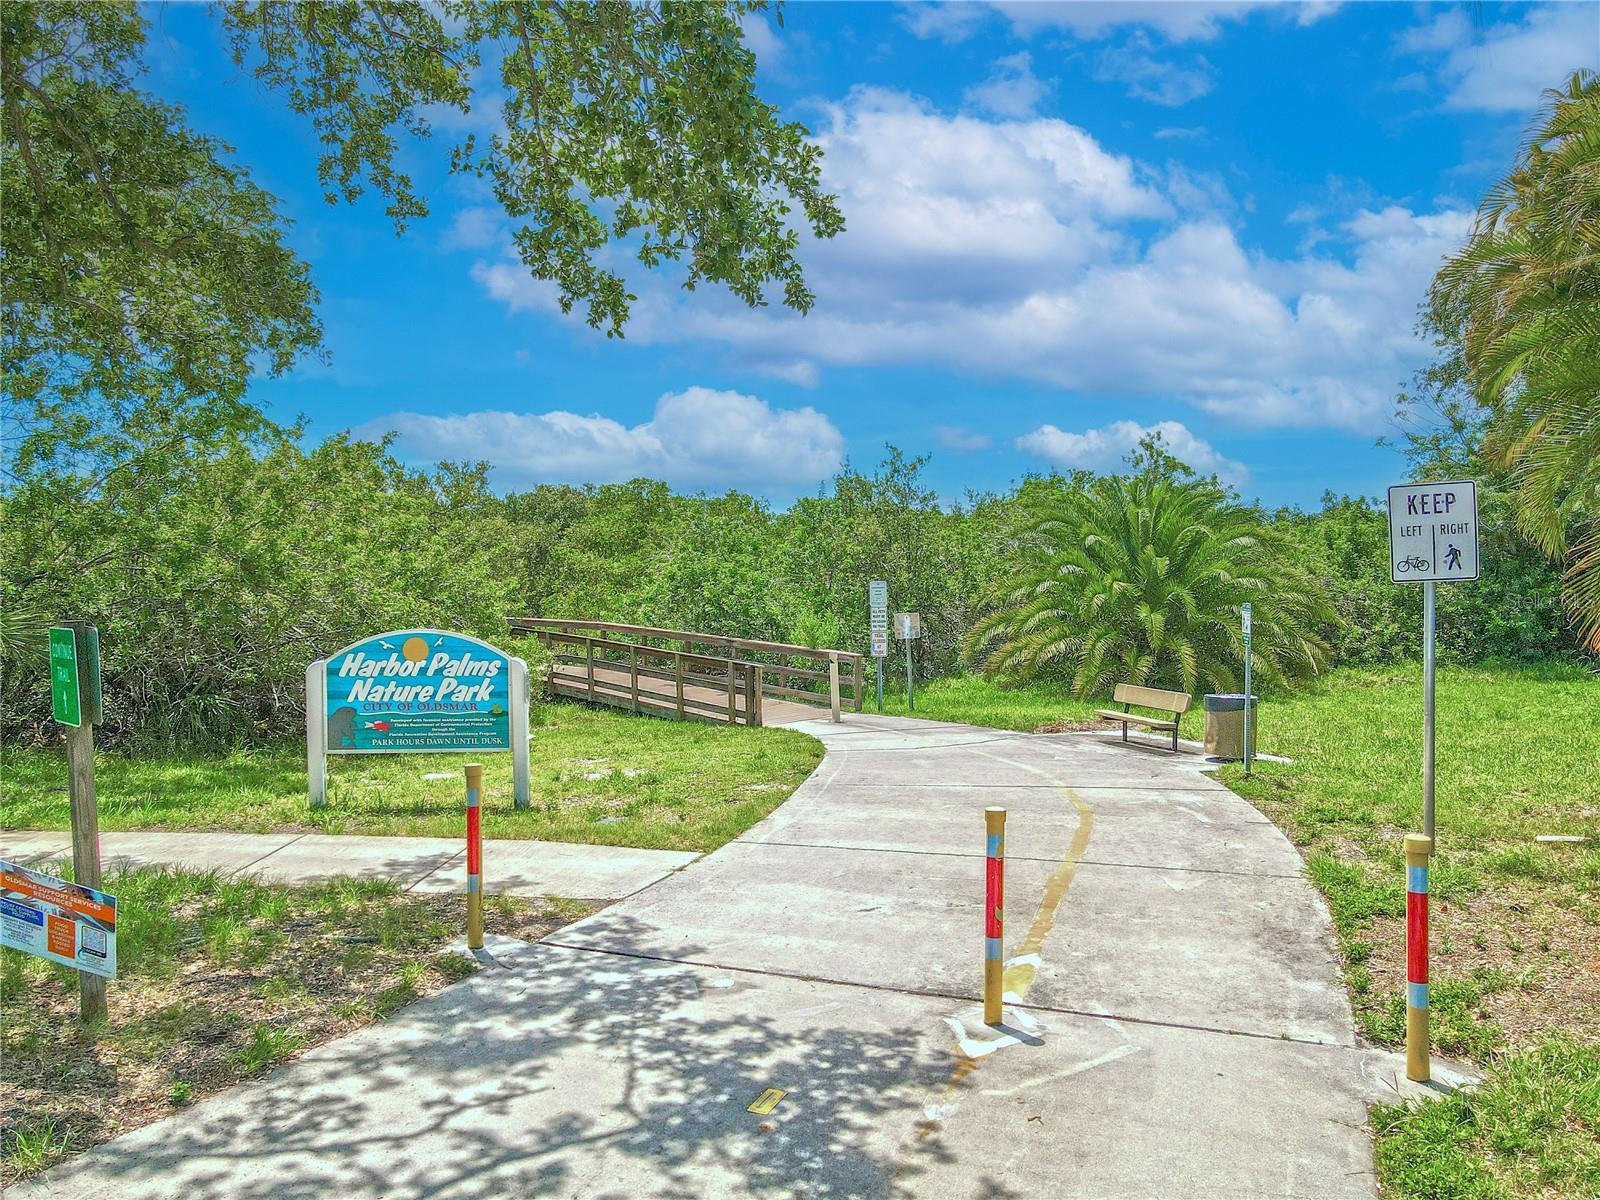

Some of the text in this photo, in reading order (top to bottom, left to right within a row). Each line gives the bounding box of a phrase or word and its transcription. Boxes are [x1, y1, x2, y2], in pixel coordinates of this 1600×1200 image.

[1407, 492, 1456, 516] KEEP
[1400, 525, 1422, 537] LEFT
[1440, 522, 1469, 535] RIGHT
[338, 652, 502, 678] Harbor Palms
[347, 678, 495, 702] Nature Park
[363, 702, 479, 711] CITY OF OLDSMAR
[372, 738, 394, 746] PARK
[397, 738, 425, 746] HOURS
[5, 876, 102, 911] OLDSMAR SUPPORT SERVICES
[33, 890, 73, 908] RESOURCES
